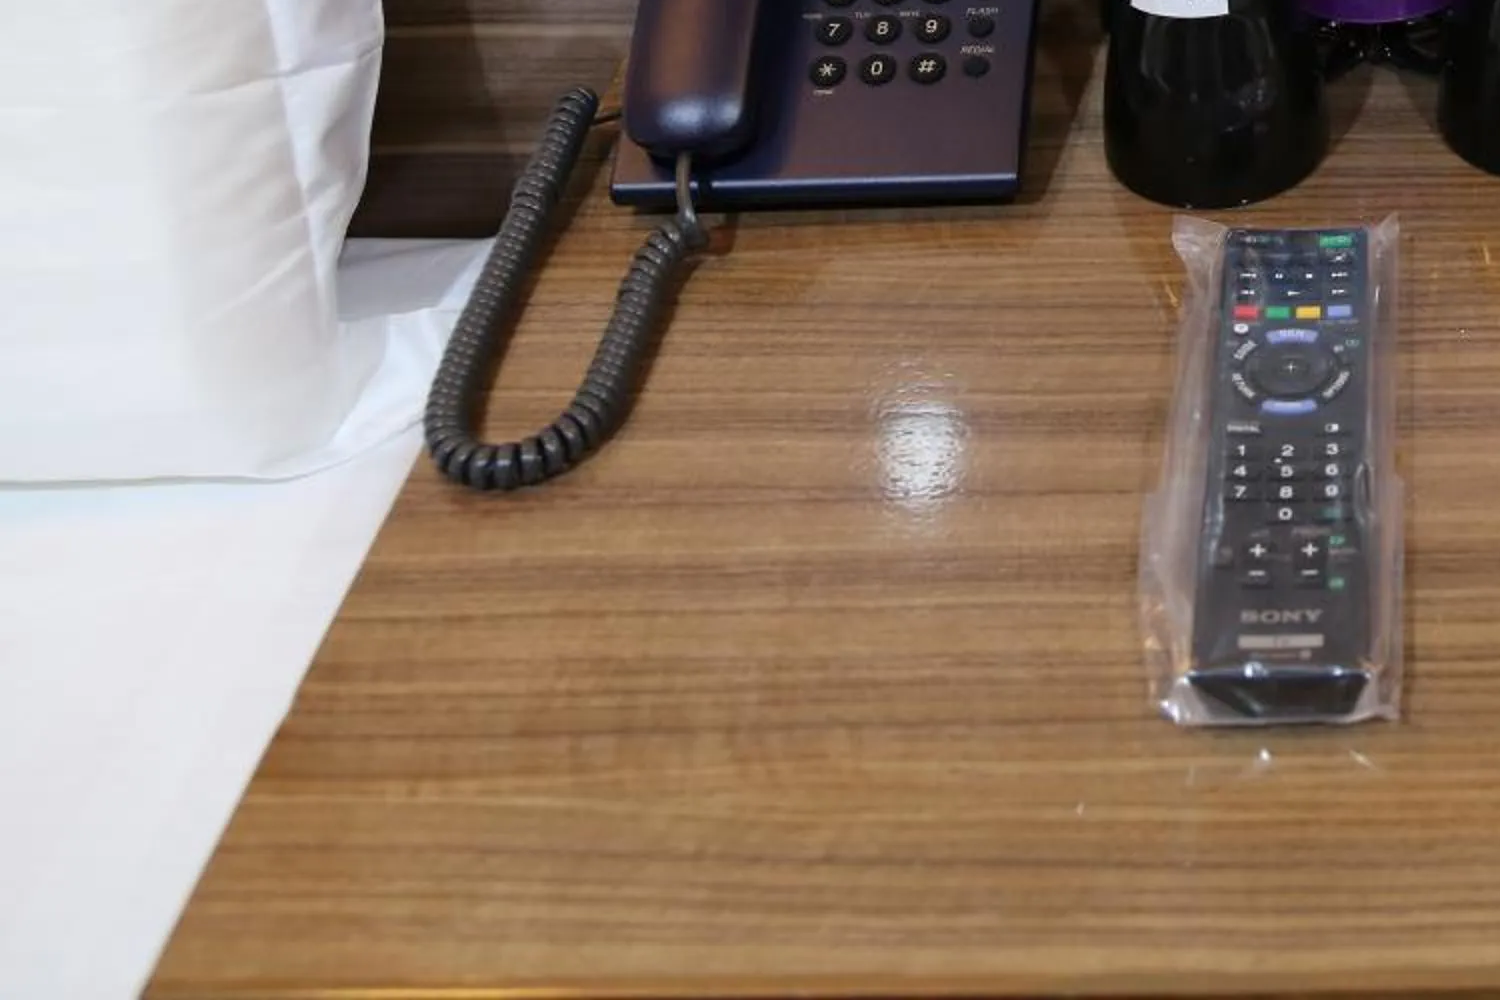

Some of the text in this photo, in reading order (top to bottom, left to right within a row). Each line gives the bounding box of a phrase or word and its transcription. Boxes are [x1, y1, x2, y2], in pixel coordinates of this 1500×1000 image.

[828, 19, 938, 37] 7 8 9
[870, 61, 883, 76] 0
[1281, 443, 1295, 457] 2
[1326, 443, 1339, 455] 3
[1233, 463, 1339, 478] 4 5 6
[1234, 484, 1339, 499] 7 8 9
[1278, 507, 1293, 521] 0
[1240, 609, 1323, 623] SONY
